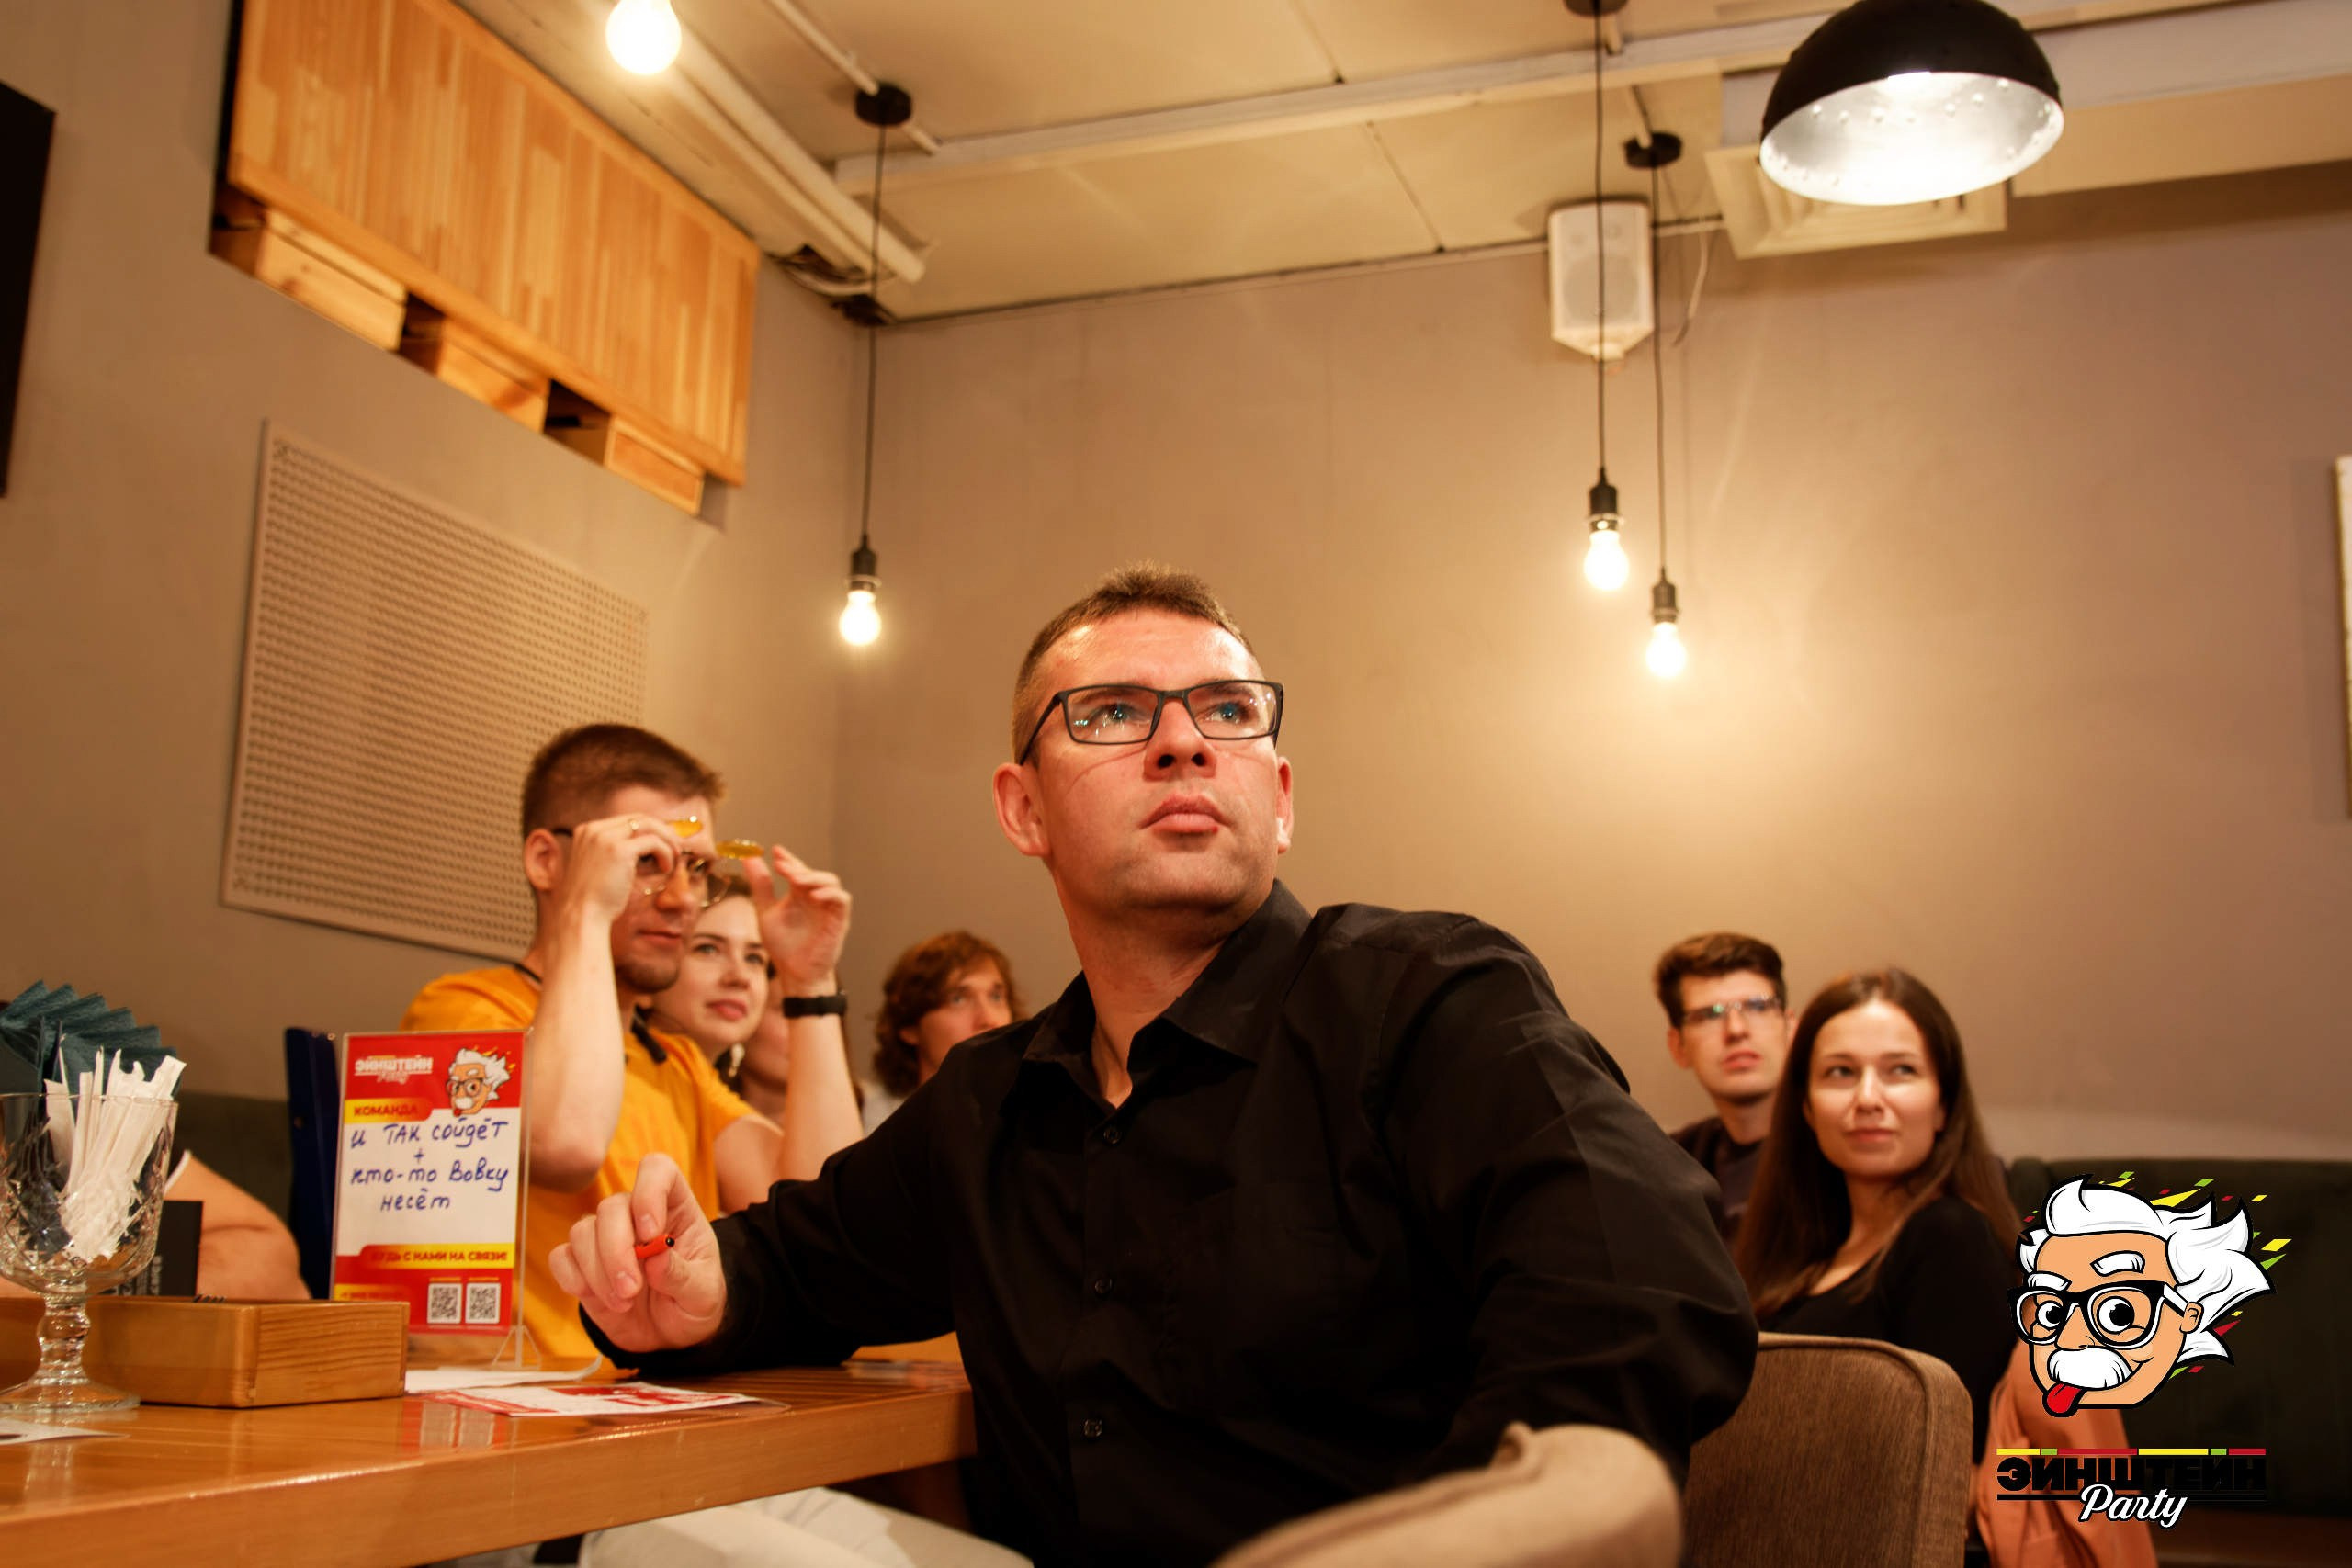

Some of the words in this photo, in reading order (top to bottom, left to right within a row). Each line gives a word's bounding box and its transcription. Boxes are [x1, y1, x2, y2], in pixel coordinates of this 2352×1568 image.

[354, 1104, 418, 1116] КОМАНДА
[383, 1123, 420, 1145] ТАК
[448, 1157, 508, 1191] Вовку
[380, 1188, 450, 1212] несёт
[403, 1251, 412, 1261] С
[413, 1251, 447, 1261] НАМИ
[449, 1251, 465, 1261] НА
